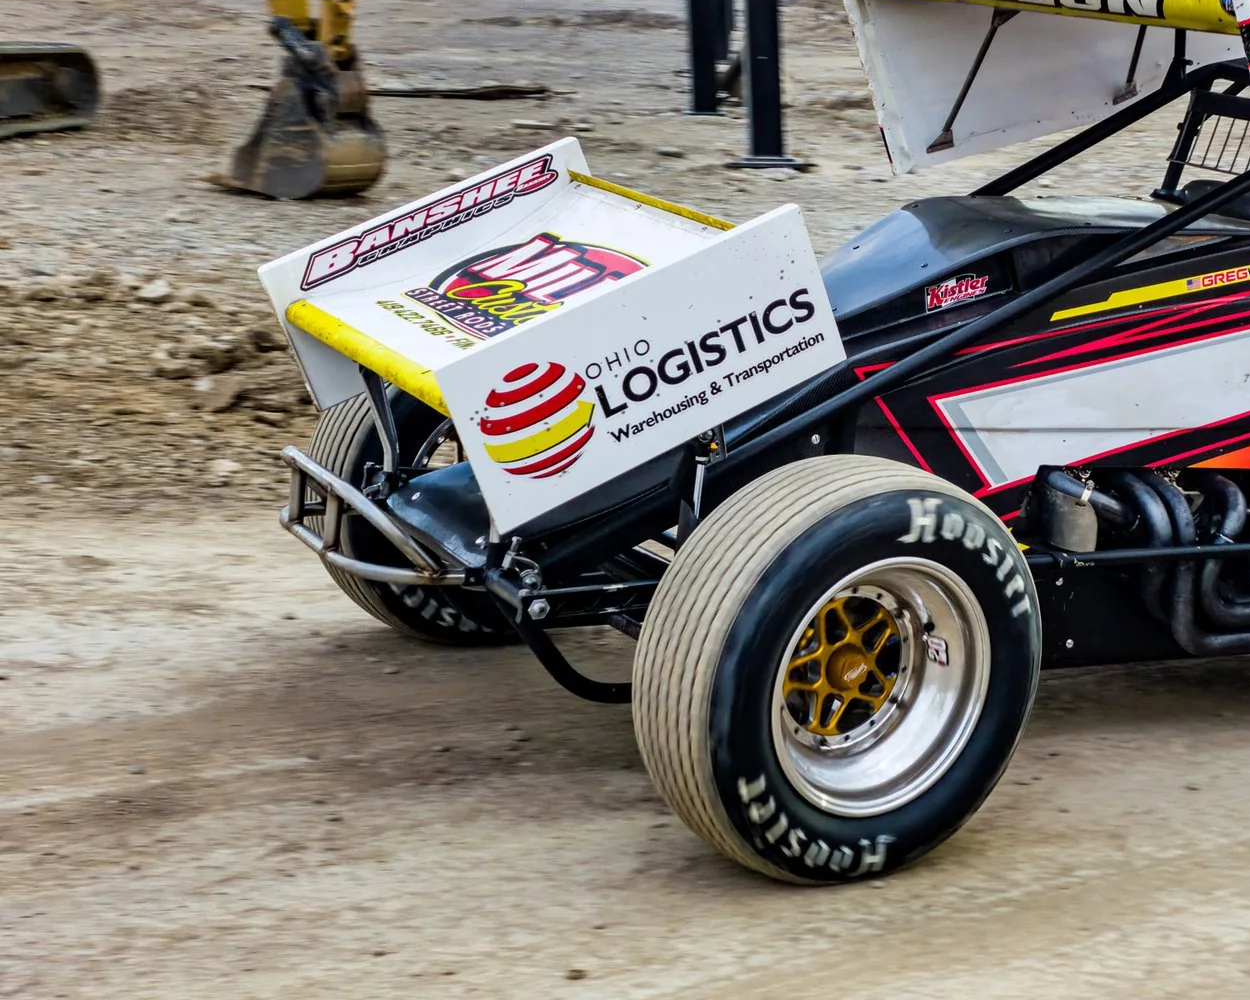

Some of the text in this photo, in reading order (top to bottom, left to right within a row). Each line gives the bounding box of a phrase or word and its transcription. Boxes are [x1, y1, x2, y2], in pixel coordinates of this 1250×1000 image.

[304, 158, 547, 286] BANSHEE
[357, 191, 515, 267] GRAPHICS
[408, 287, 504, 334] STREET RODS
[928, 276, 988, 308] Kistler
[585, 340, 650, 379] OHIO
[594, 288, 815, 418] LOGISTICS
[610, 332, 824, 443] Warehousing & Transportation
